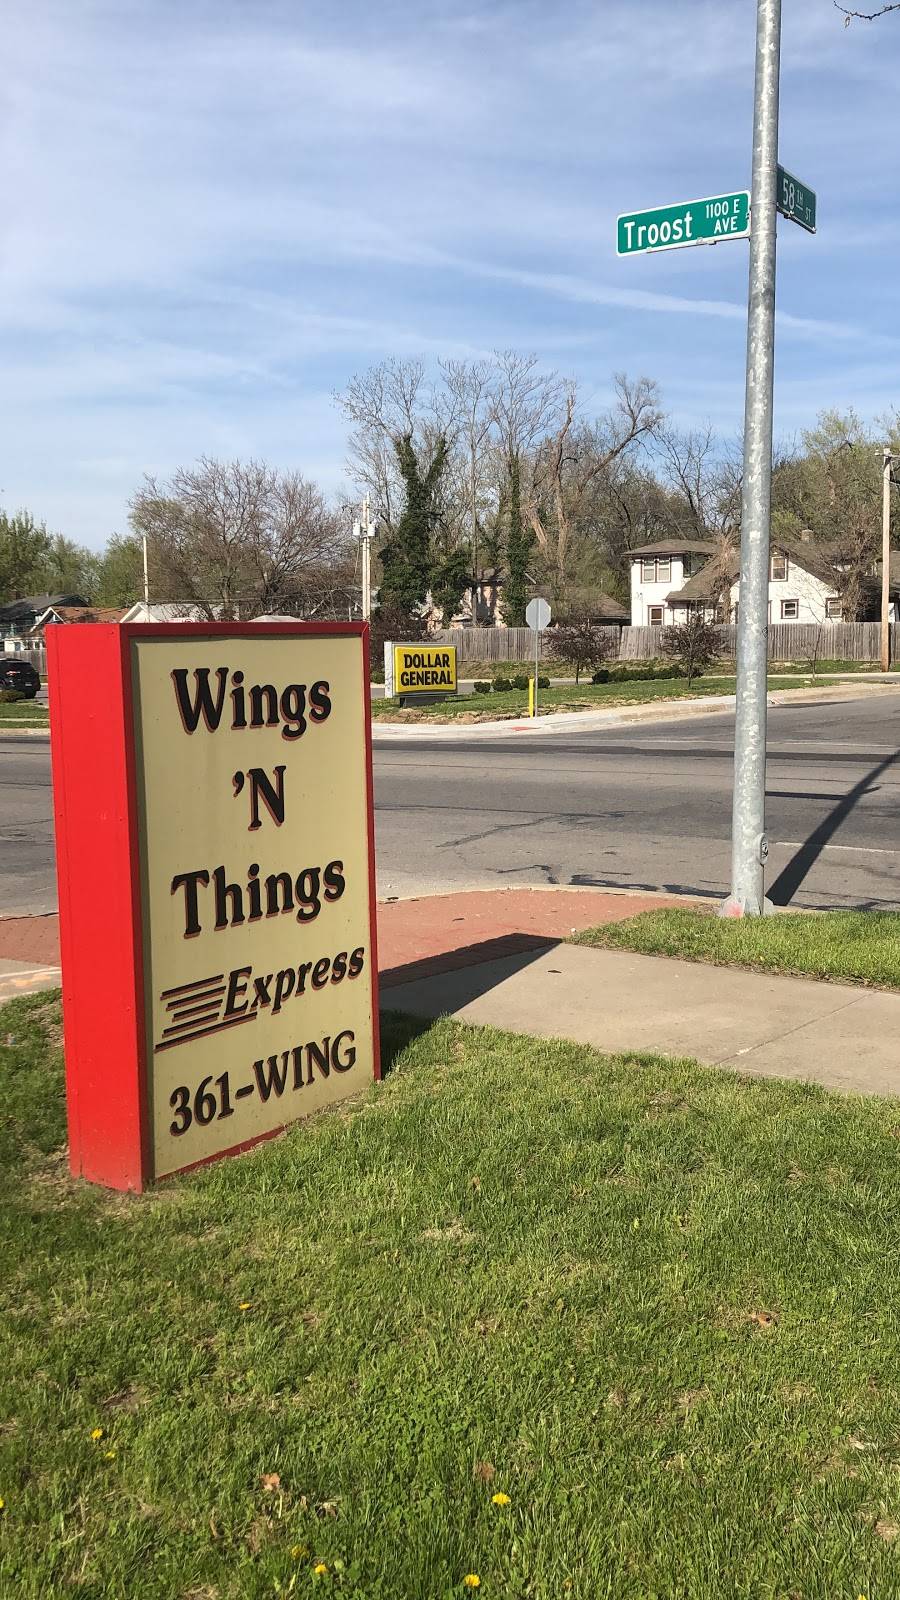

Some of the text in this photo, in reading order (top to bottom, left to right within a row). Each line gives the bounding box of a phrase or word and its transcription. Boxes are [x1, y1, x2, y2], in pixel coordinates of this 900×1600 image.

[705, 198, 740, 219] 1100 E
[714, 215, 738, 234] AVE
[805, 206, 812, 222] ST
[623, 211, 693, 249] Troost
[400, 670, 453, 686] GENERAL
[403, 653, 450, 669] DOLLAR
[170, 667, 332, 741] Wings
[231, 765, 287, 832] 'N
[170, 860, 346, 939] Things
[222, 946, 365, 1020] Express
[169, 1029, 357, 1137] 361-WING
